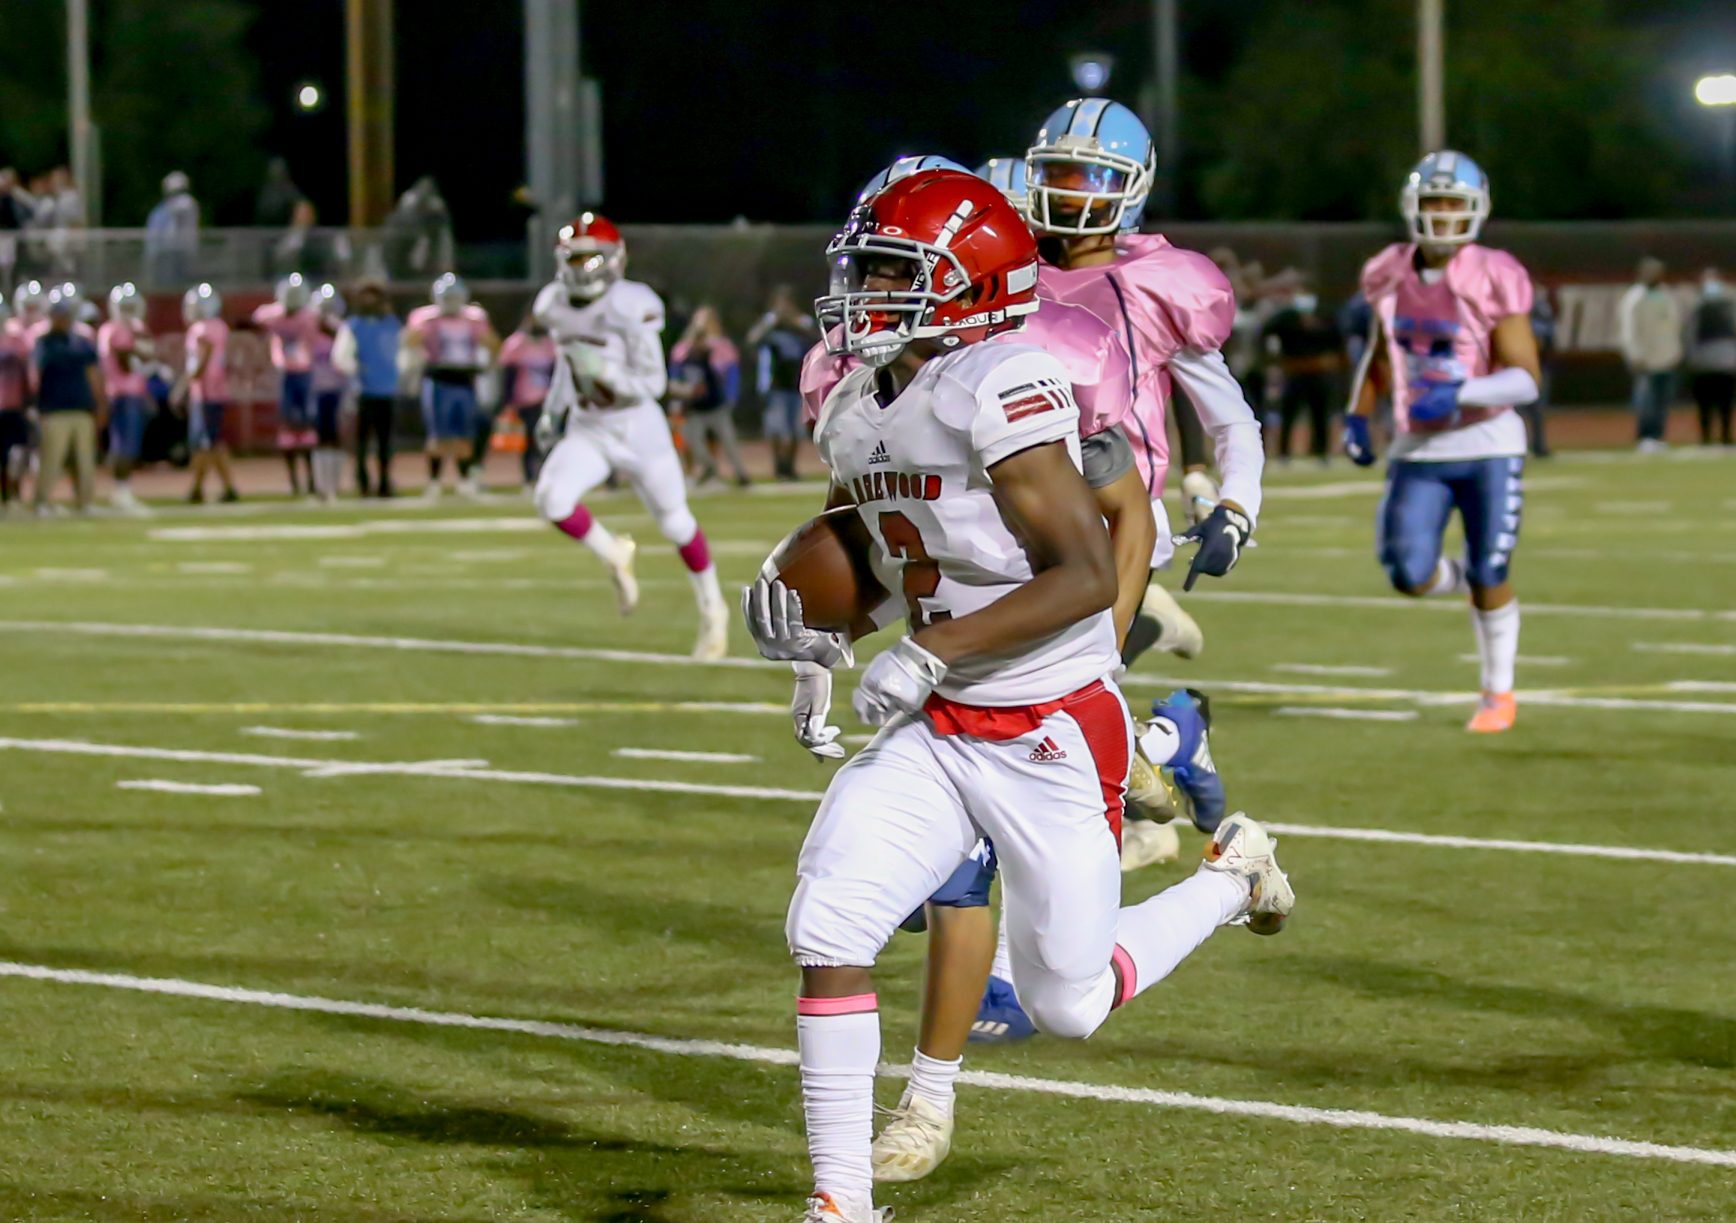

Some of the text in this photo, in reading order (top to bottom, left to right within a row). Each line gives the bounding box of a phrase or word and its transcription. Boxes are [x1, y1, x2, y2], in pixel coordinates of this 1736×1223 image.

[844, 470, 942, 506] AKEWOOD
[878, 510, 954, 632] 2
[1029, 750, 1067, 761] adidas
